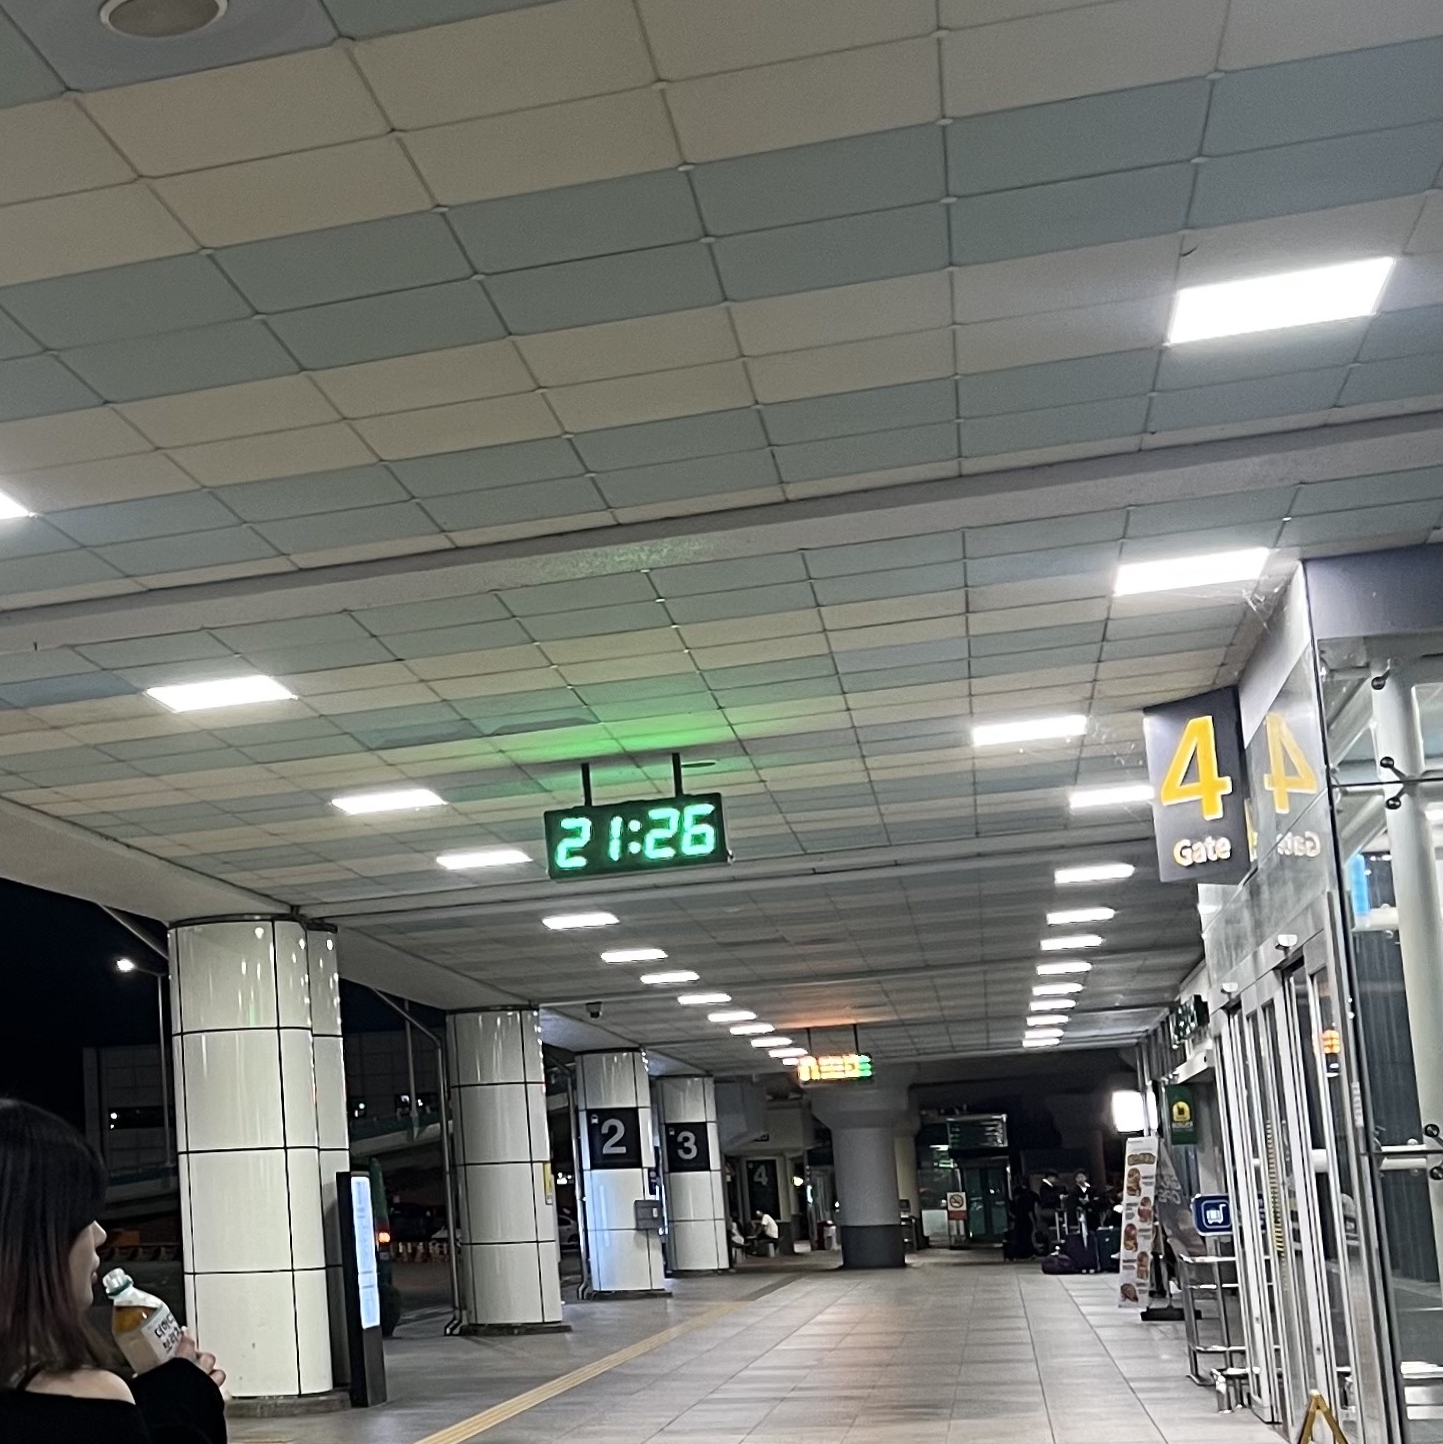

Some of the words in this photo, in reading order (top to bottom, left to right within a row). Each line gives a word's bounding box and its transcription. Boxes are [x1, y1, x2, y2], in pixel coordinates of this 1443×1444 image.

[1160, 715, 1233, 821] 4
[555, 803, 716, 869] 21:26
[1173, 834, 1232, 867] Gate
[601, 1118, 628, 1155] 2
[676, 1131, 698, 1160] 3
[753, 1164, 770, 1187] 4
